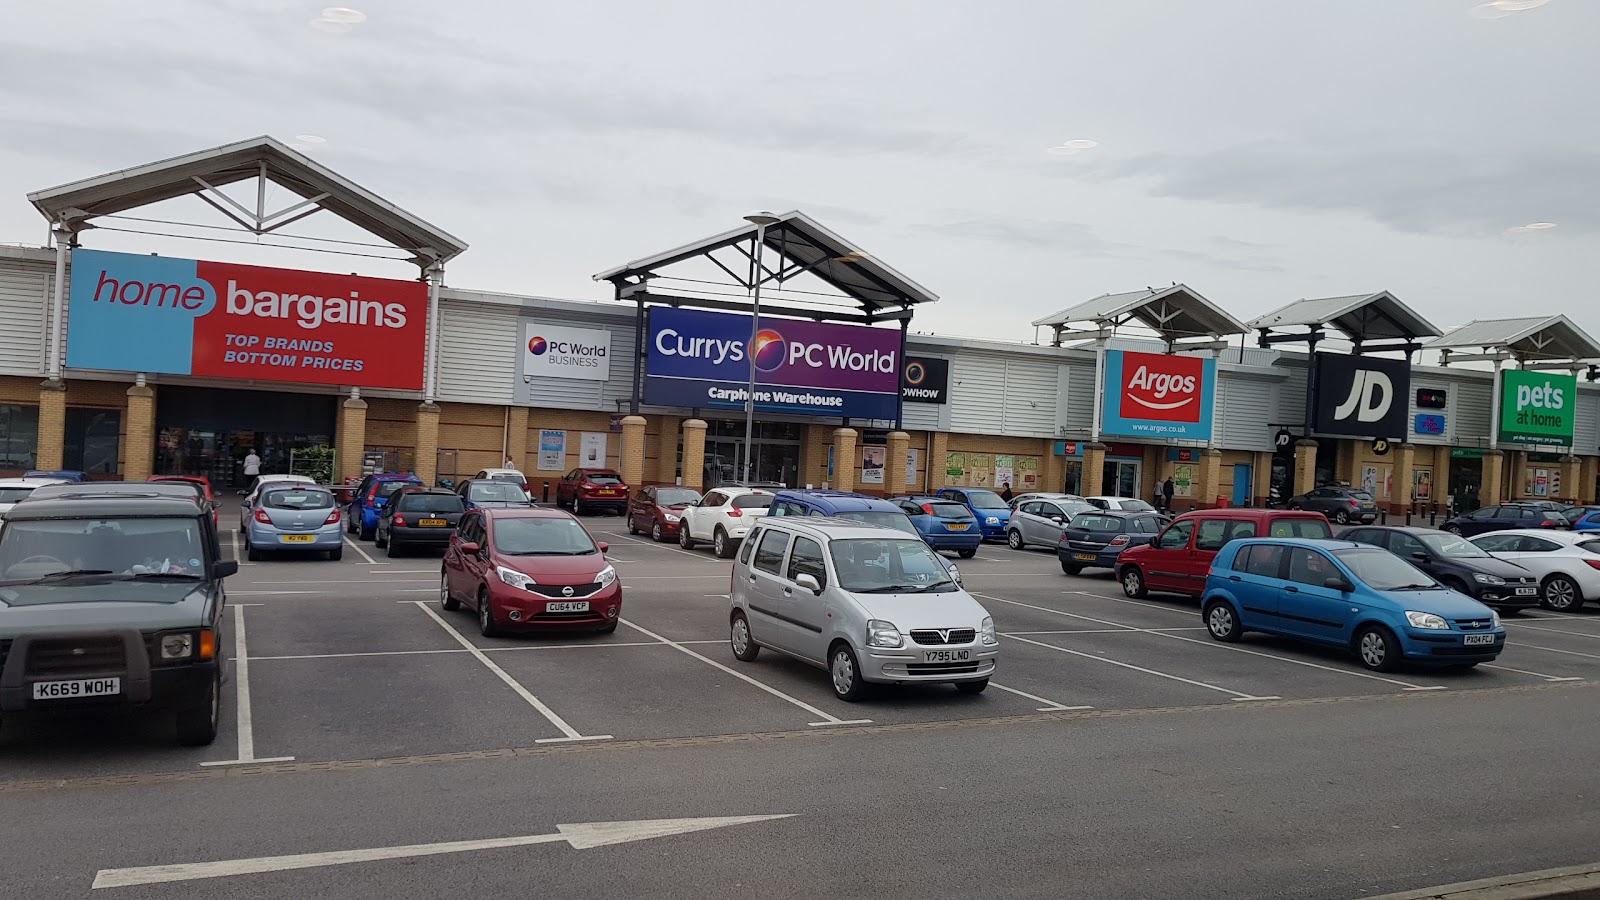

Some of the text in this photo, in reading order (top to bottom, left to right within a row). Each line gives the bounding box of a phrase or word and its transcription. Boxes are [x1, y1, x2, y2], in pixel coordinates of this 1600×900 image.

[93, 270, 407, 329] home bargains
[225, 333, 334, 353] TOP BRANDS
[549, 341, 606, 357] PC World
[655, 328, 895, 374] Currys PC World
[223, 351, 364, 372] BOTTOM PRICES
[548, 355, 599, 368] BUSINESS
[1128, 365, 1196, 399] Argos
[772, 391, 843, 407] Warehouse
[1334, 369, 1394, 423] JD
[1516, 381, 1564, 412] pets
[1516, 409, 1562, 428] at home
[1132, 424, 1186, 434] www.argos.co.uk
[1276, 434, 1290, 446] JD
[1373, 440, 1387, 451] JD
[549, 602, 586, 611] CU64 VCP
[1466, 635, 1493, 644] PX04 FCJ
[925, 650, 969, 661] Y795 LND
[39, 680, 114, 697] K669 WOH
